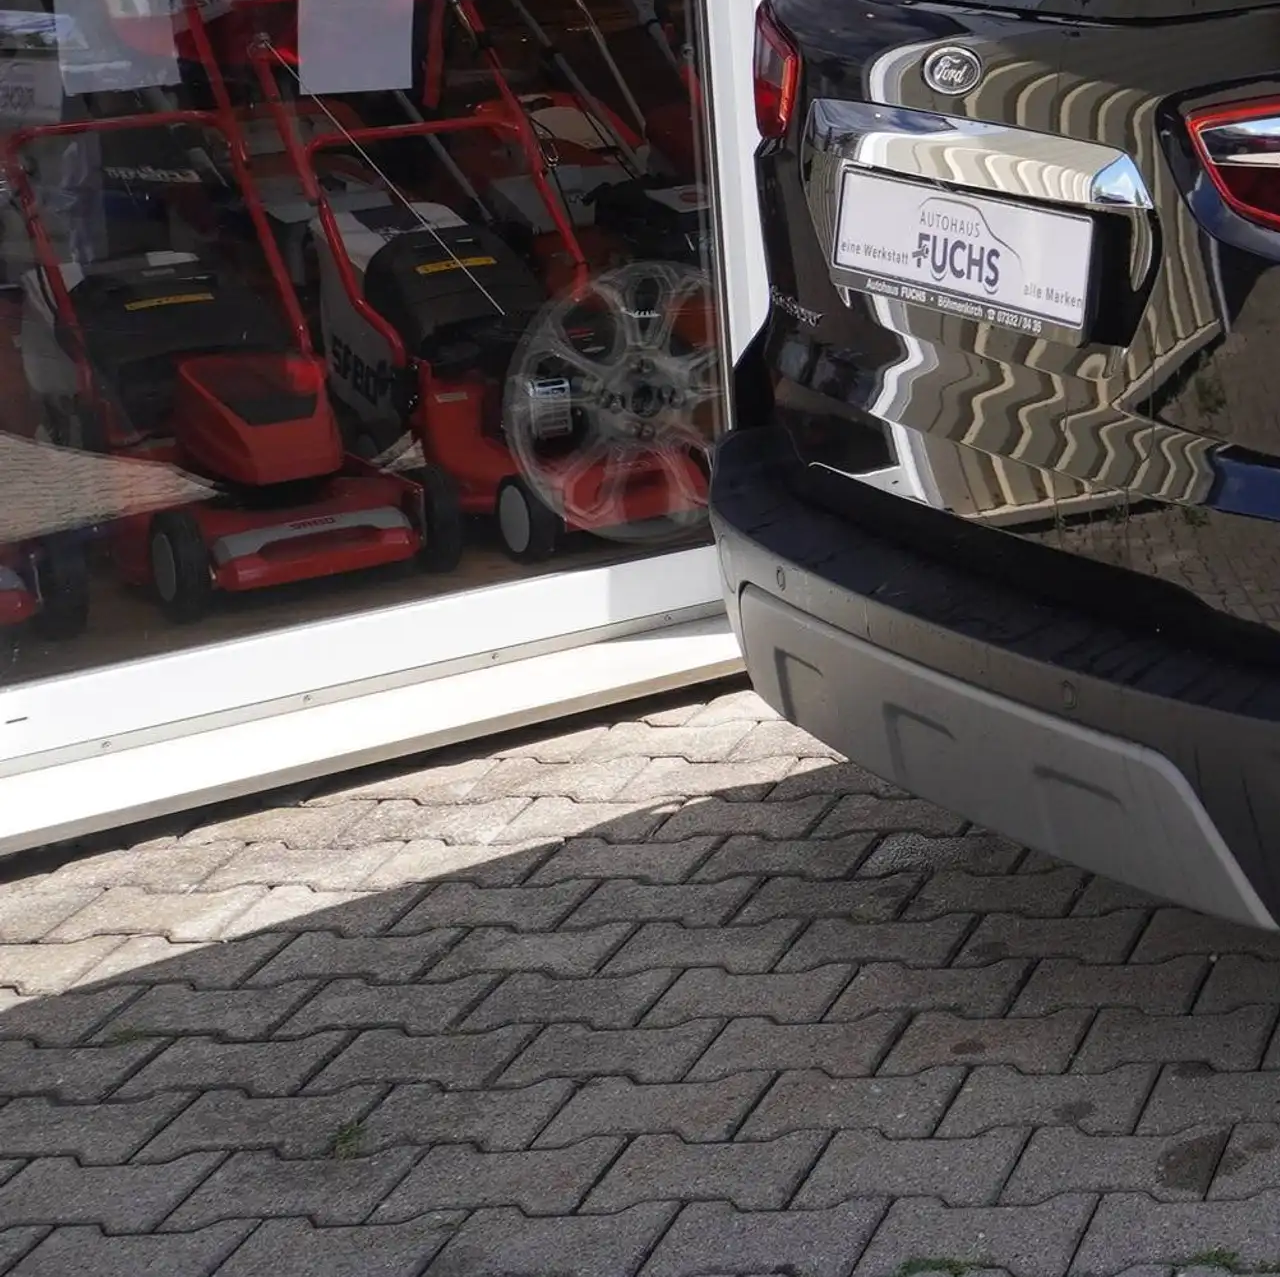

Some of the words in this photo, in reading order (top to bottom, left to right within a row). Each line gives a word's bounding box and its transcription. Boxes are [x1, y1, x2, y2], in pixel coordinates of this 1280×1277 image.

[933, 55, 968, 84] Ford
[920, 210, 981, 238] AUTOHAUS
[916, 232, 1001, 288] FUCHS
[901, 286, 927, 302] FUCHS
[1045, 286, 1082, 309] Marken
